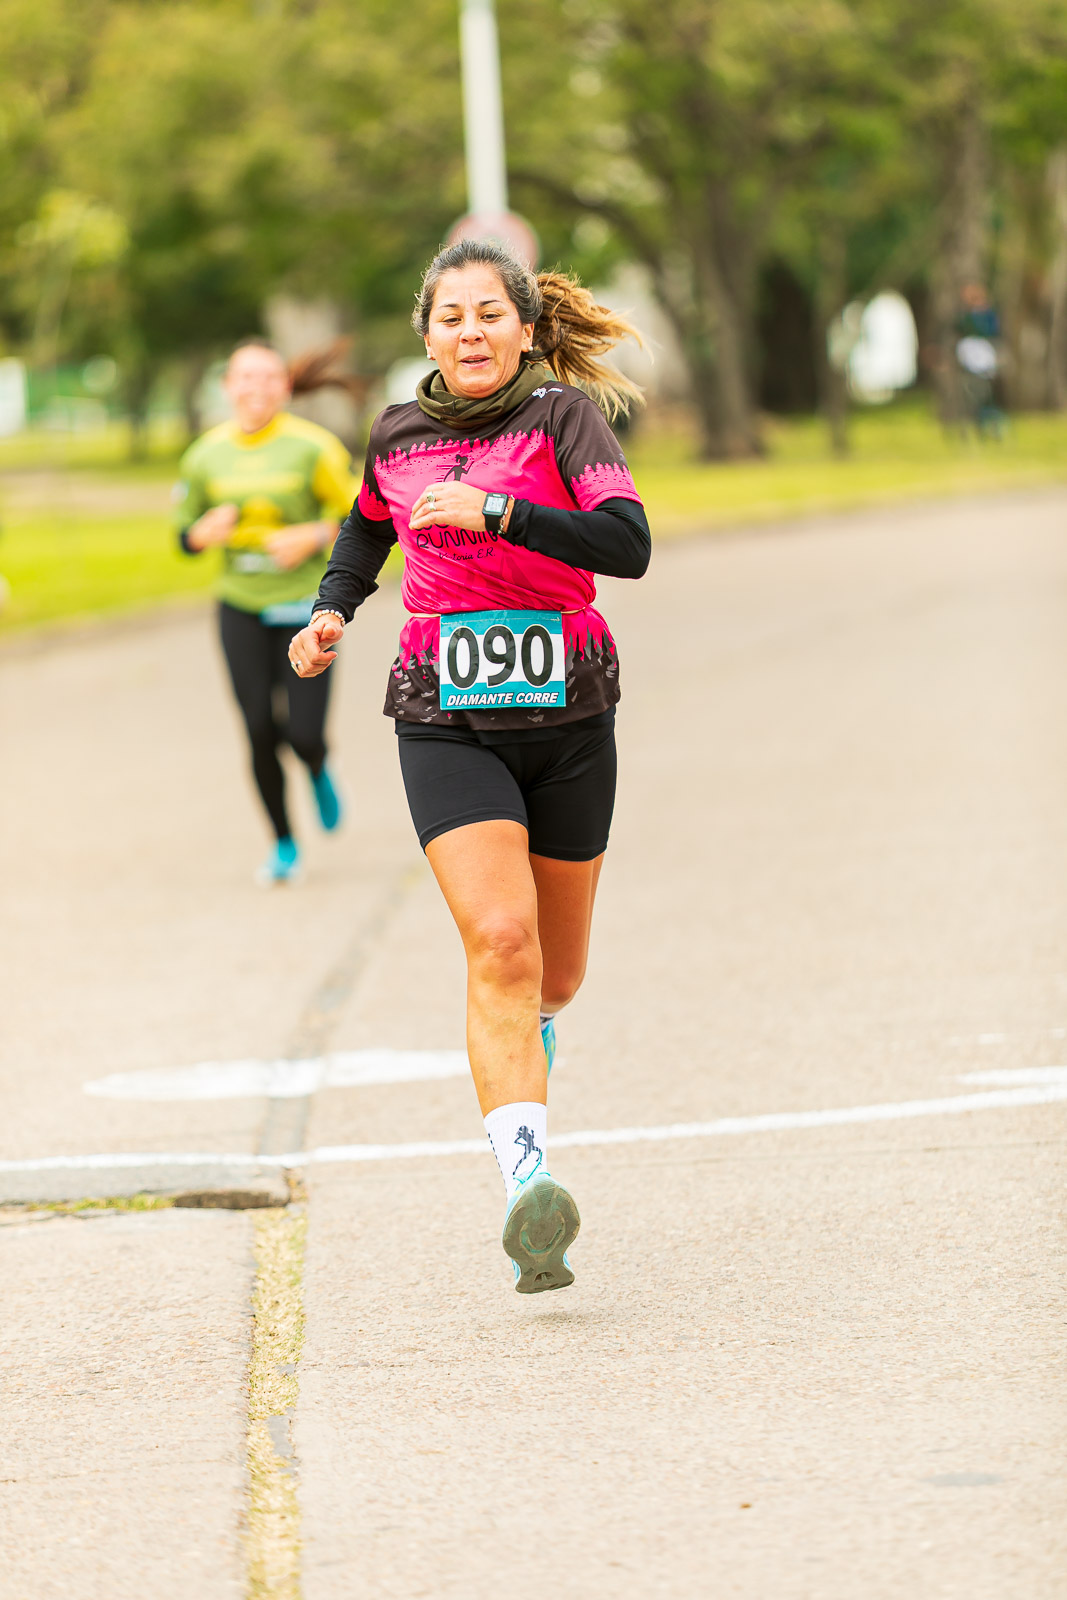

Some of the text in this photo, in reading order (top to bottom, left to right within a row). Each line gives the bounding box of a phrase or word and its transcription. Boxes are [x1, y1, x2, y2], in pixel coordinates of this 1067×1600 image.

[416, 528, 499, 549] RUNNIN
[447, 624, 554, 690] 090
[446, 691, 560, 707] DIAMANTE CORRE
